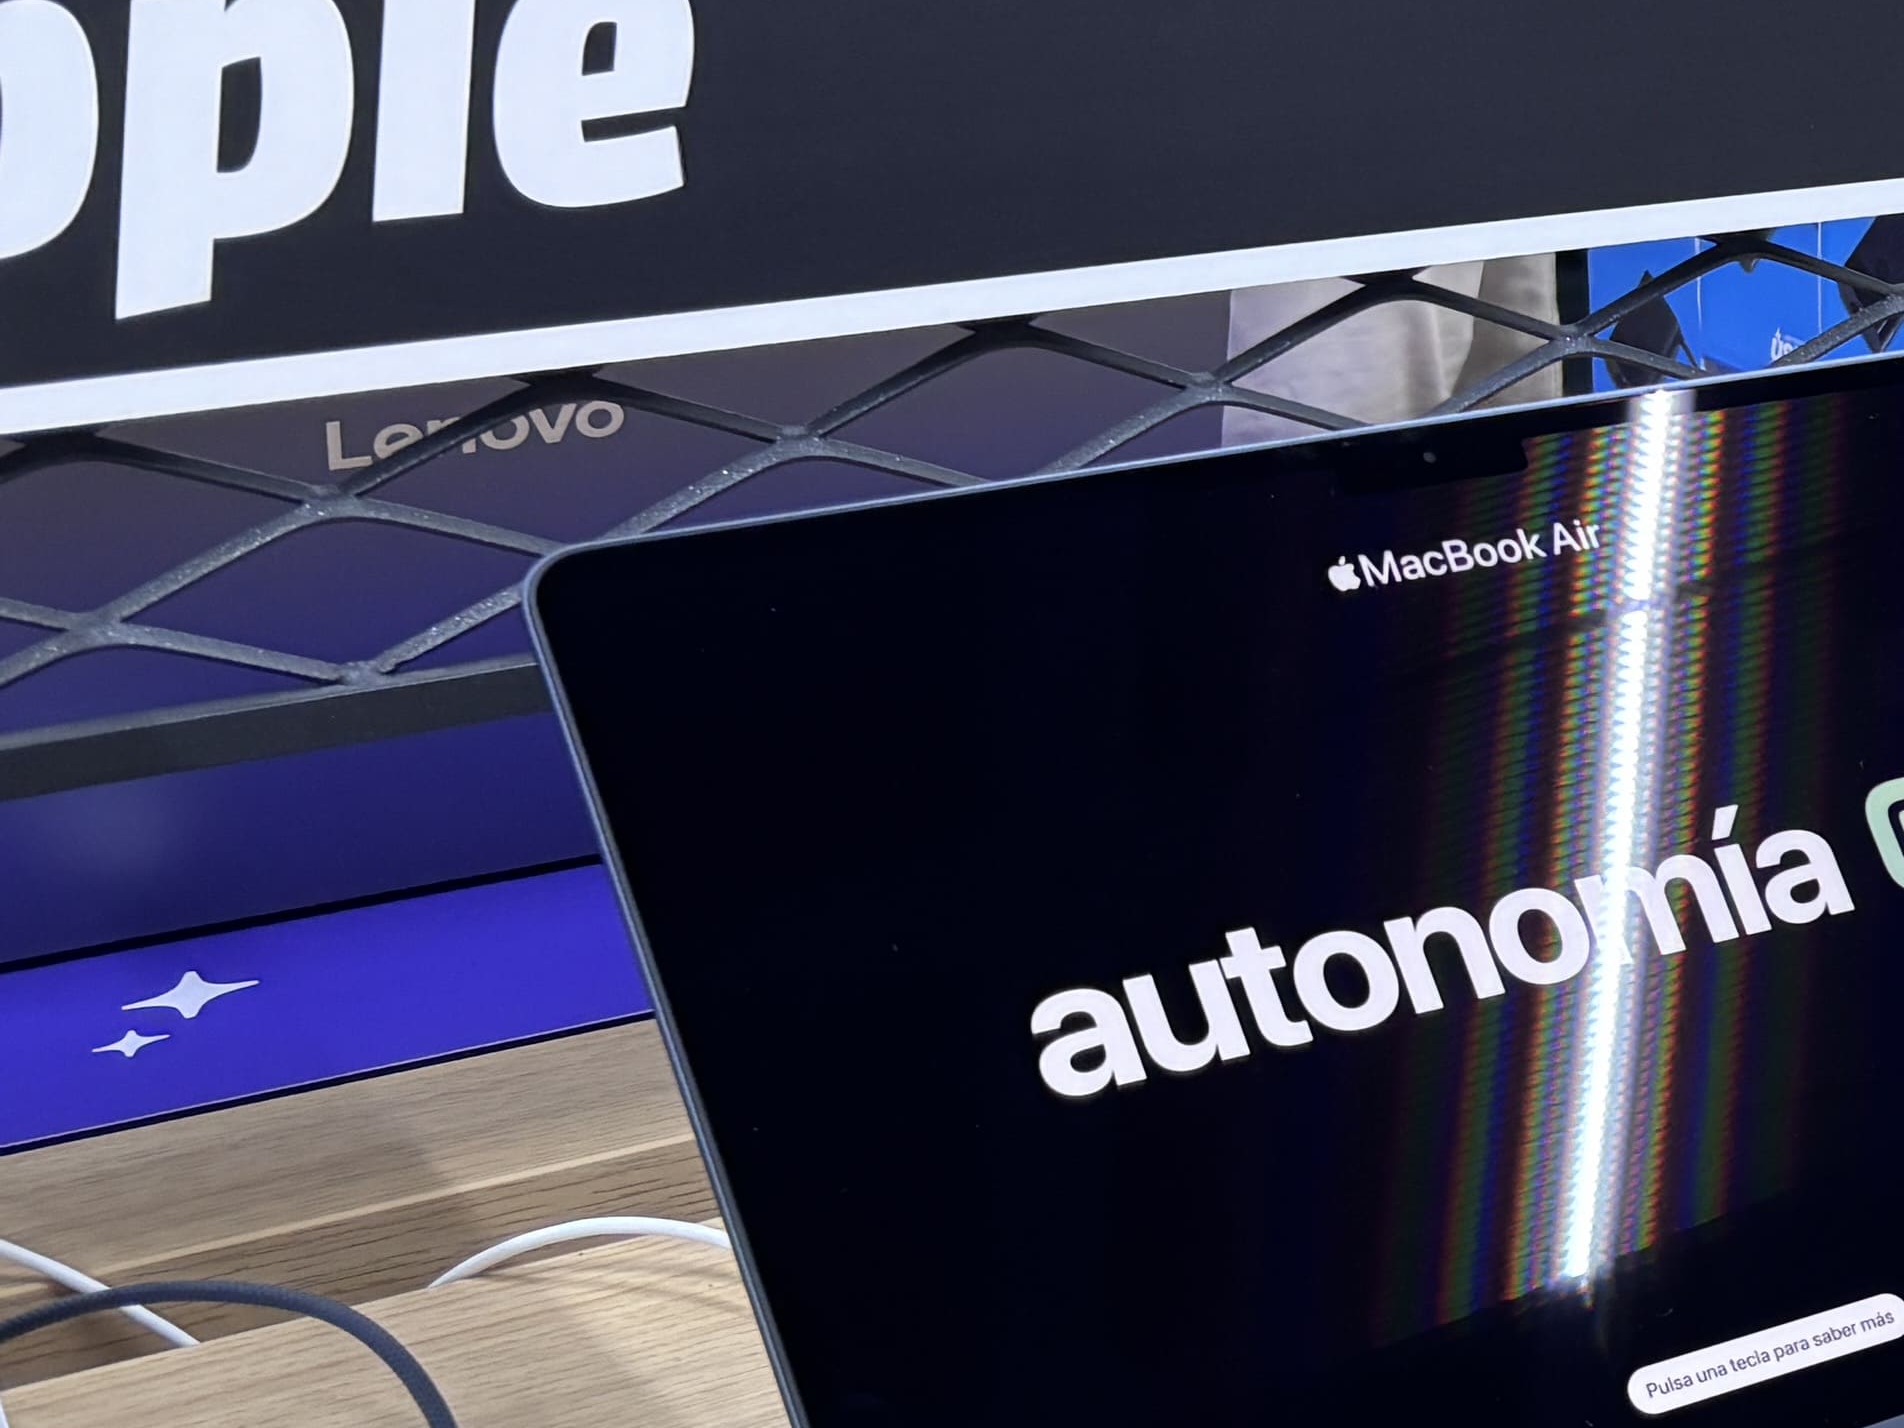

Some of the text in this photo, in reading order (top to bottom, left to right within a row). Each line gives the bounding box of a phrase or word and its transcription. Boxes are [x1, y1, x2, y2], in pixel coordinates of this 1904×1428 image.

[1357, 518, 1601, 588] MacBook Air
[1030, 801, 1856, 1097] autonomía
[1645, 1310, 1895, 1399] Pulsa una tecla para saber más
